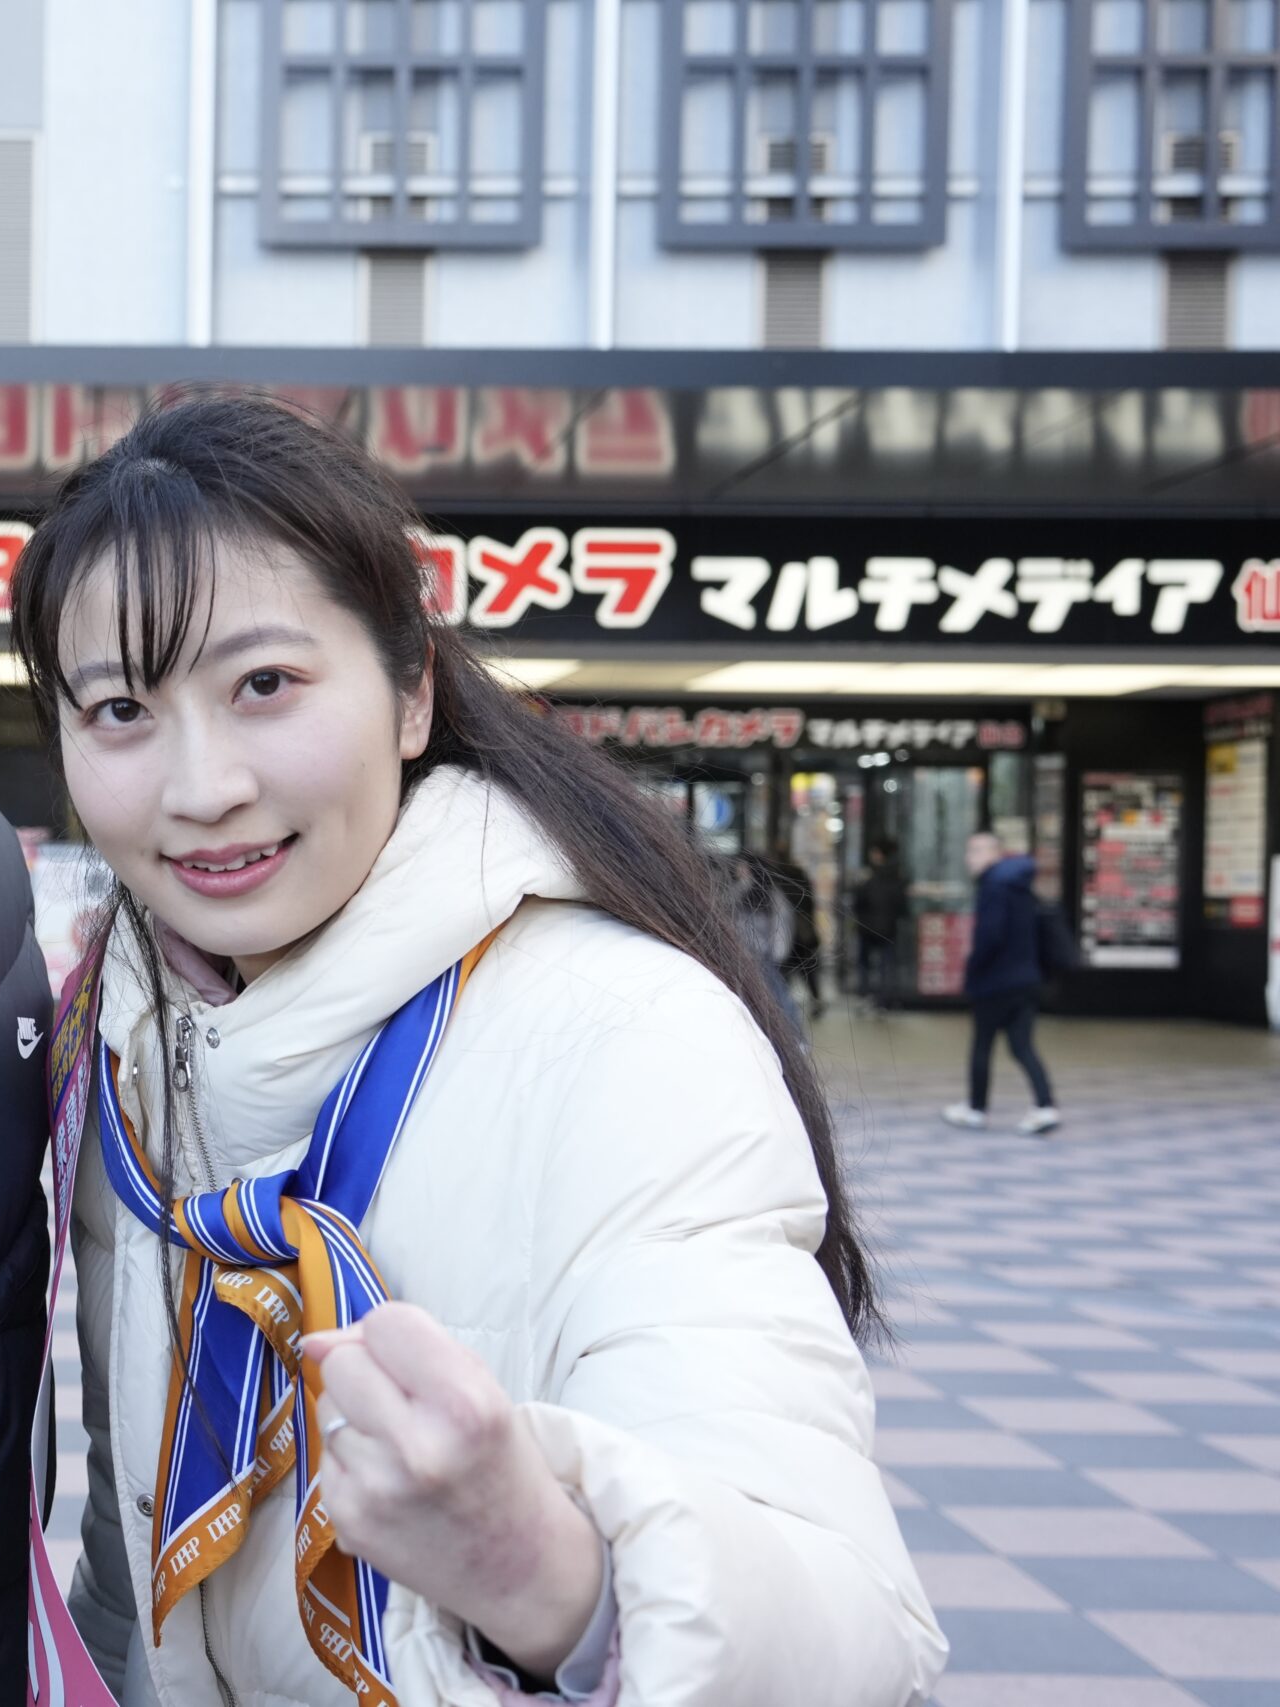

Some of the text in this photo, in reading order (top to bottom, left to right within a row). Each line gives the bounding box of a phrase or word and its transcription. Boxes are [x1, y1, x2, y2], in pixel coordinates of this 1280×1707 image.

[691, 556, 1223, 634] マルチメディア
[17, 1017, 36, 1040] NIKE
